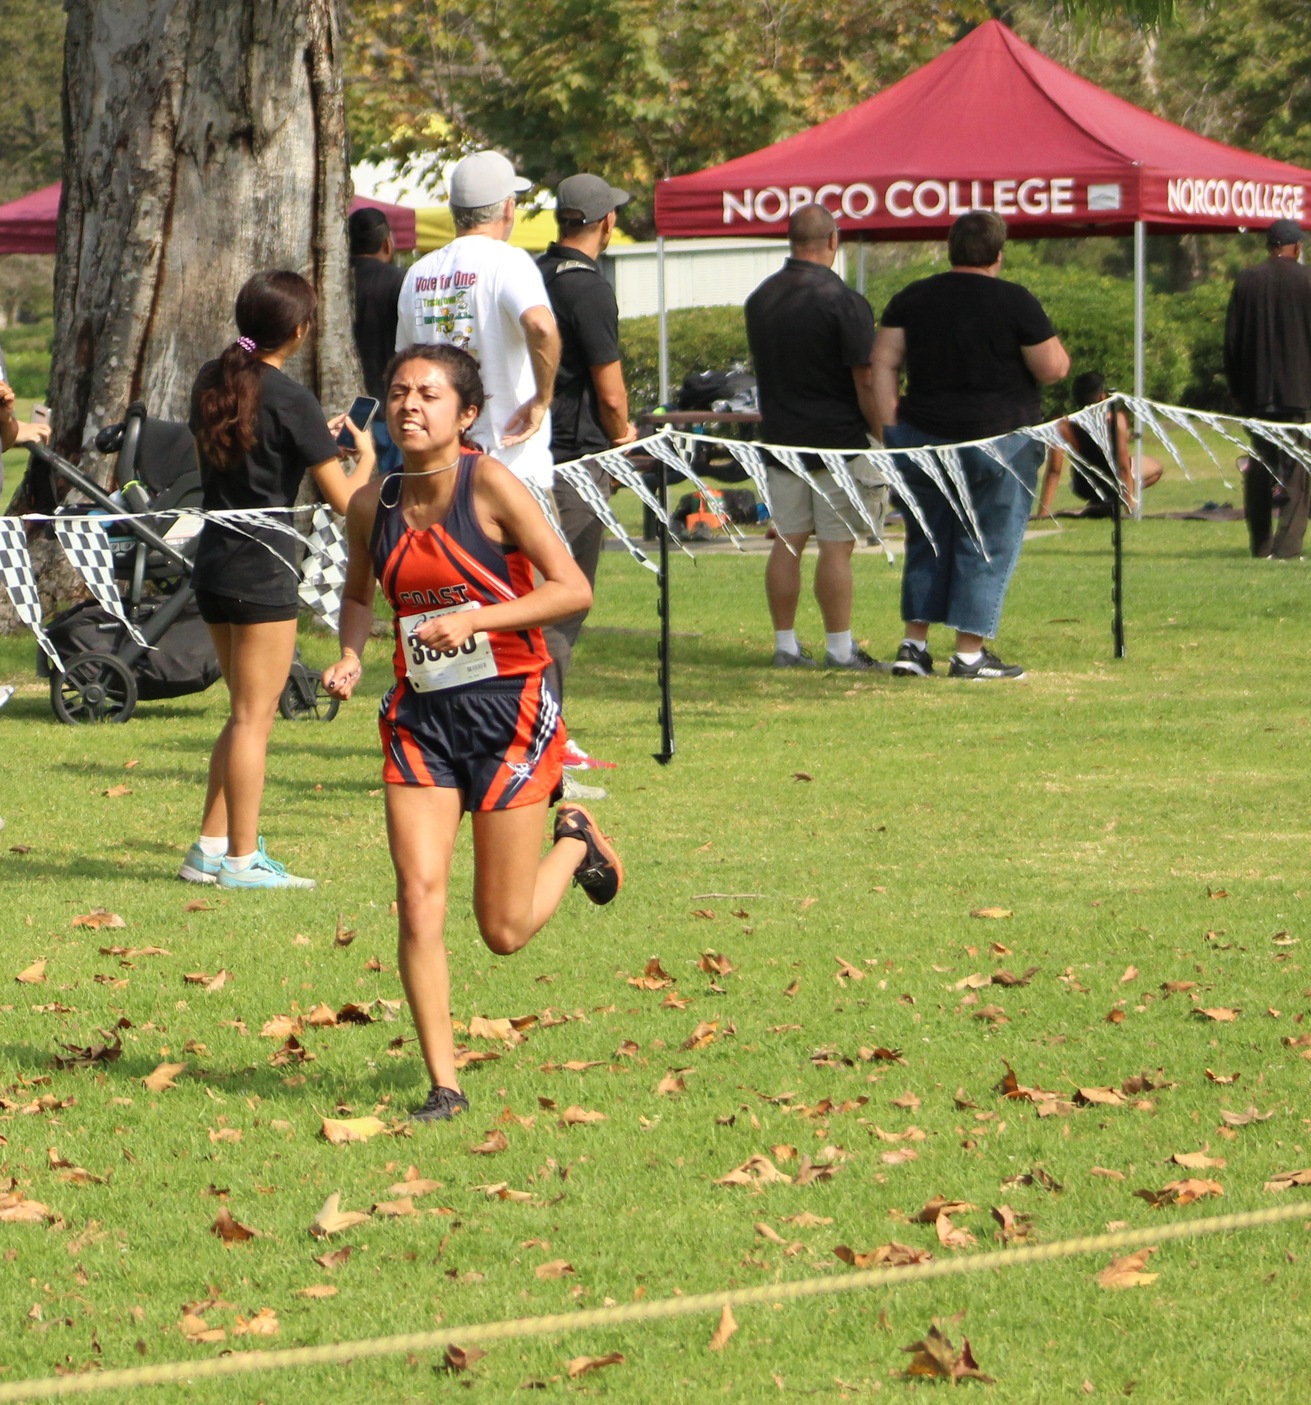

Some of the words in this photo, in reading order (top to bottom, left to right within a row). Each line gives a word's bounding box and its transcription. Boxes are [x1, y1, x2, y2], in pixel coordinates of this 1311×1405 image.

[885, 177, 1075, 217] COLLEGE
[1167, 178, 1229, 216] NORCO
[1231, 179, 1305, 220] COLLEGE
[415, 276, 437, 293] Vote
[454, 270, 477, 288] One
[399, 584, 469, 606] COAST
